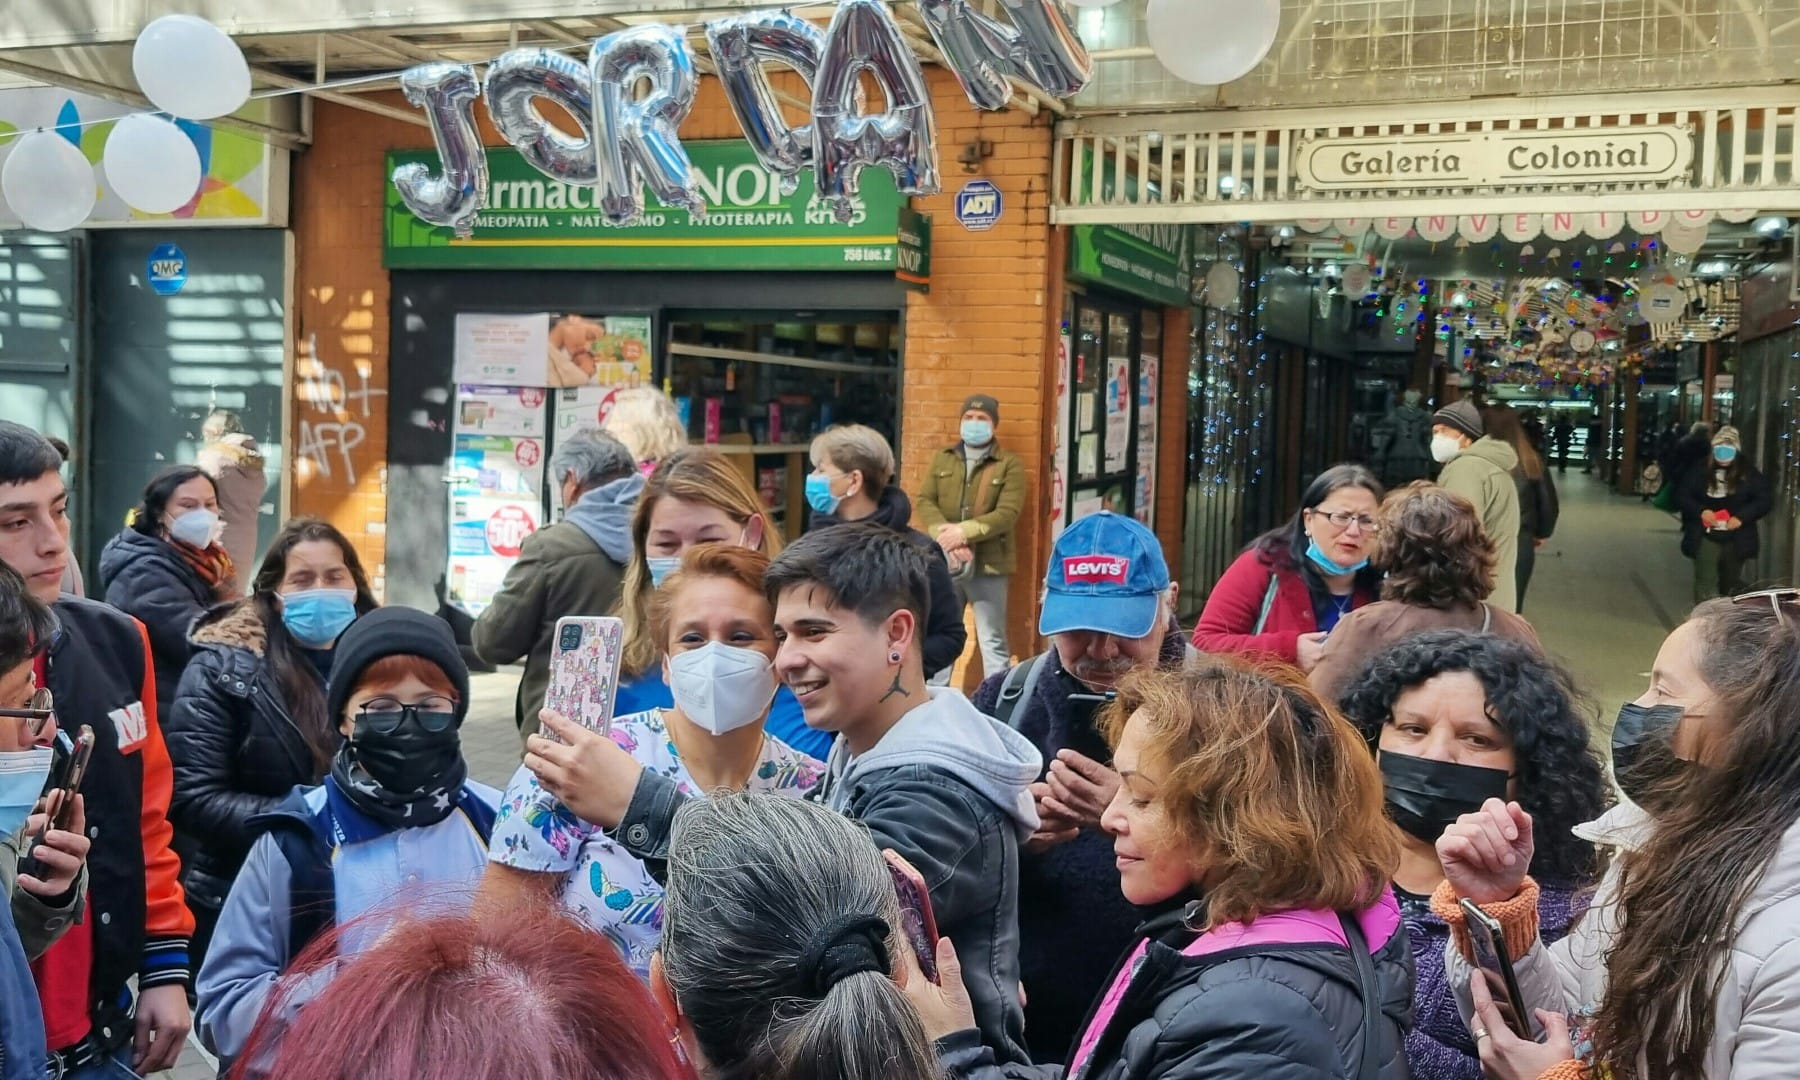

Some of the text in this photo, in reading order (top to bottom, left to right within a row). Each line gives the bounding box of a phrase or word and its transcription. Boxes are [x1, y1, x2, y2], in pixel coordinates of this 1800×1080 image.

[1341, 141, 1649, 175] Galería Colonial
[963, 195, 997, 215] ADT
[884, 247, 892, 261] 2
[897, 247, 921, 272] KNOP
[299, 420, 366, 485] AFP
